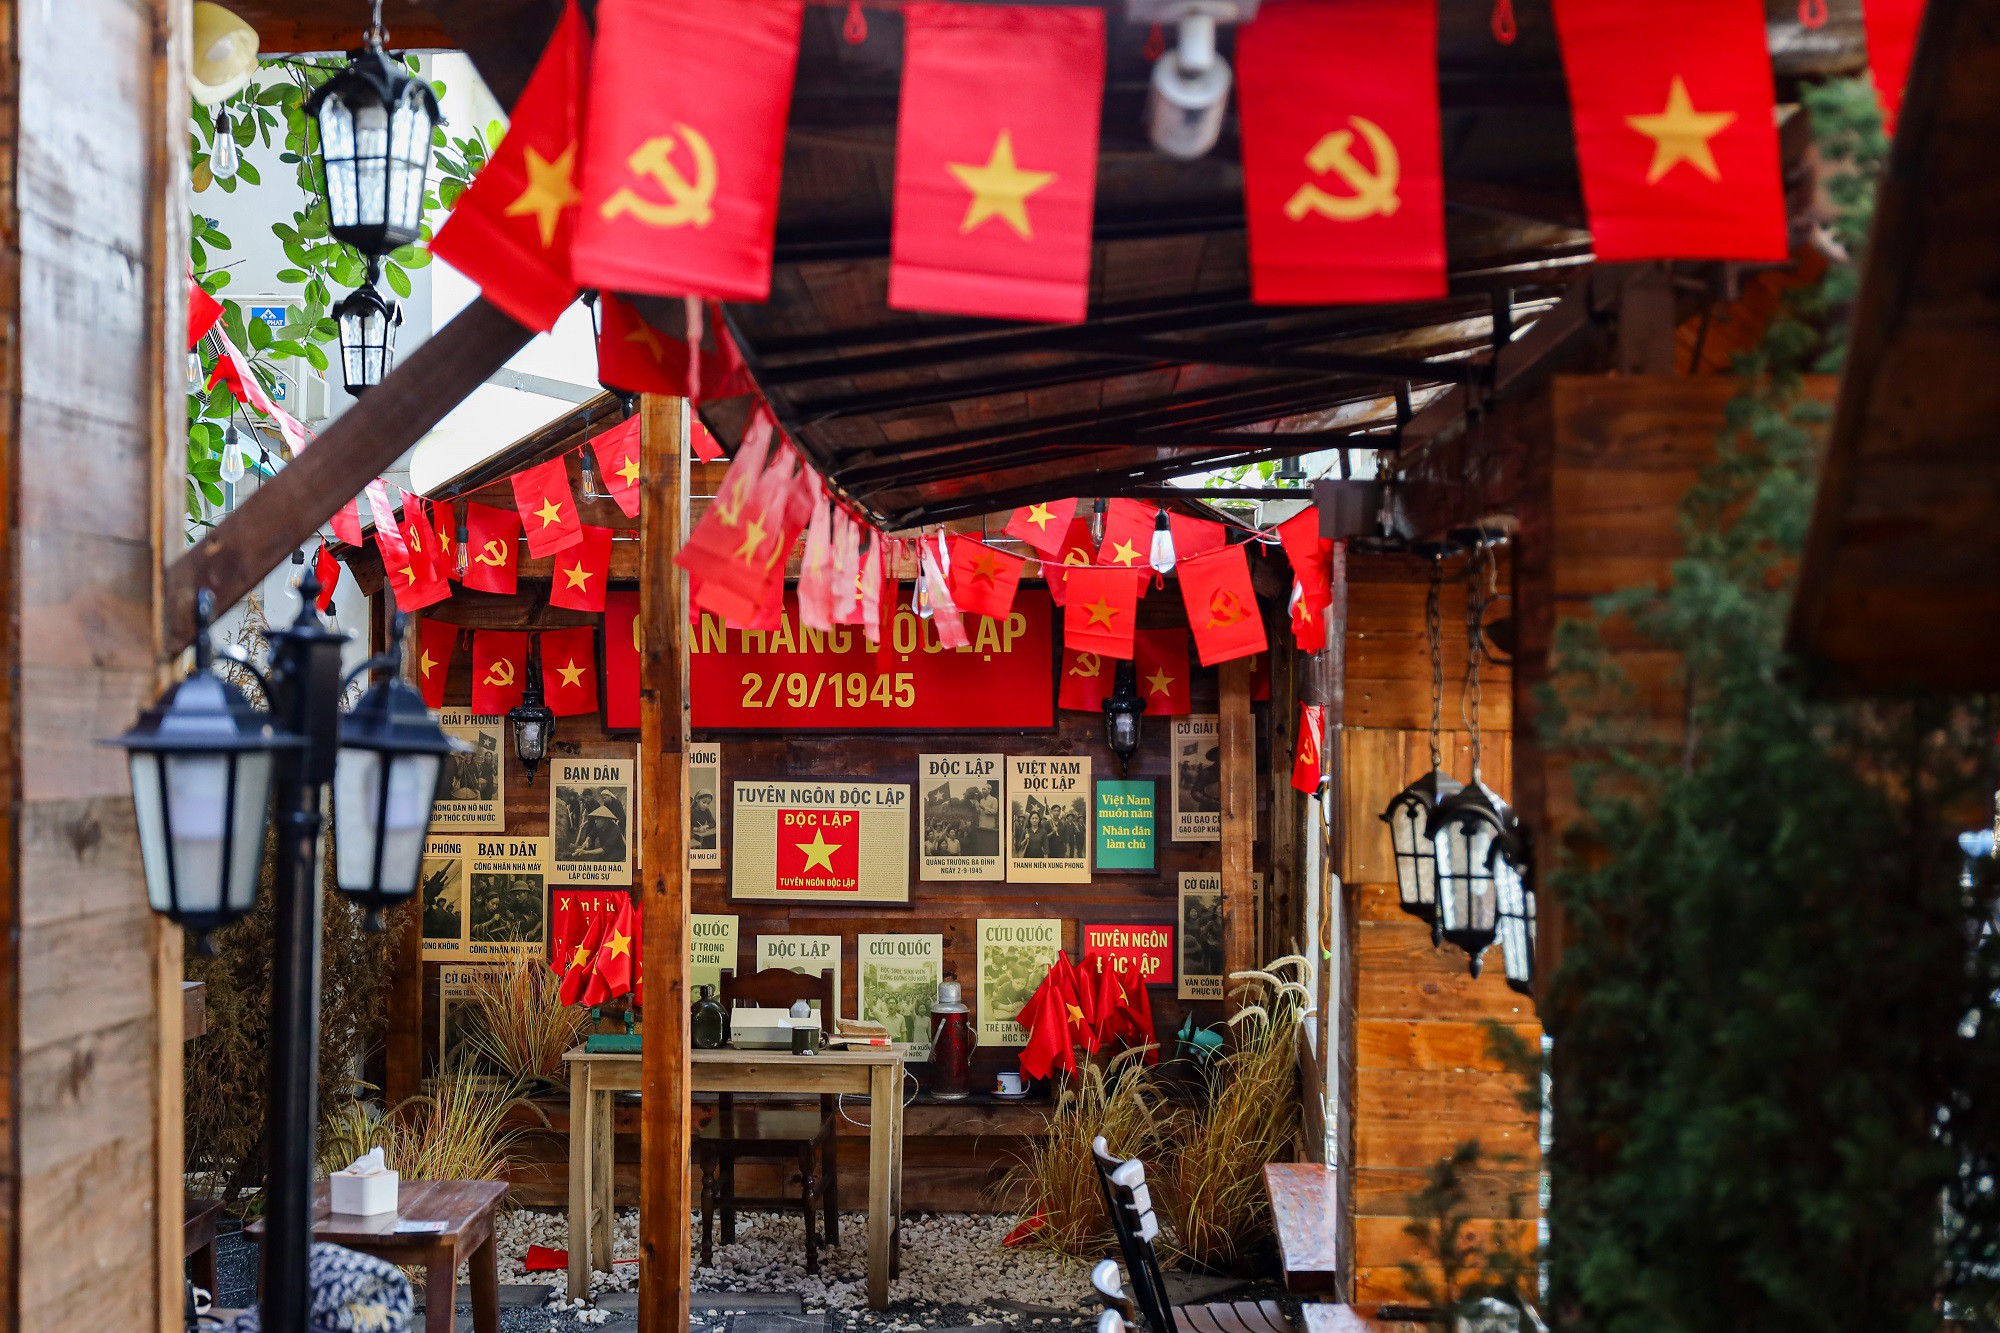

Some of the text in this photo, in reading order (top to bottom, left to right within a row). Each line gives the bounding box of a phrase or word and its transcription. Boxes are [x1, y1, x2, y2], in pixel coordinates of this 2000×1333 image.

[741, 672, 916, 708] 2/9/1945
[442, 711, 461, 725] GIẢI
[690, 750, 717, 764] HÓNG
[563, 765, 620, 782] BẠN DÂN
[929, 758, 995, 778] ĐỘC LẬP
[1017, 759, 1080, 776] VIỆT NAM
[1023, 776, 1076, 791] ĐỘC LẬP
[737, 785, 905, 808] TUYÊN NGÔN ĐỘC LẬP
[1102, 794, 1151, 808] Việt Nam
[784, 812, 853, 829] ĐỘC LẬP
[1099, 809, 1153, 818] muôn năm
[1102, 825, 1151, 836] Nhân dân
[431, 840, 462, 854] PHÓNG
[478, 841, 537, 858] BẠN DÂN
[1106, 838, 1147, 849] làm chủ
[780, 876, 856, 888] TUYÊN NGÔN ĐỘC LẬP
[1184, 876, 1219, 890] CỜ GIẢI
[692, 920, 730, 937] QUỐC
[985, 923, 1053, 942] CỨU QUỐC
[1089, 928, 1168, 948] TUYÊN NGÔN
[699, 942, 725, 952] TRONG
[767, 940, 831, 960] ĐỘC LẬP
[870, 939, 931, 956] CỨU QUỐC
[1191, 987, 1211, 996] PHỤC
[1001, 1024, 1012, 1032] EM
[1002, 1034, 1018, 1042] HỌC
